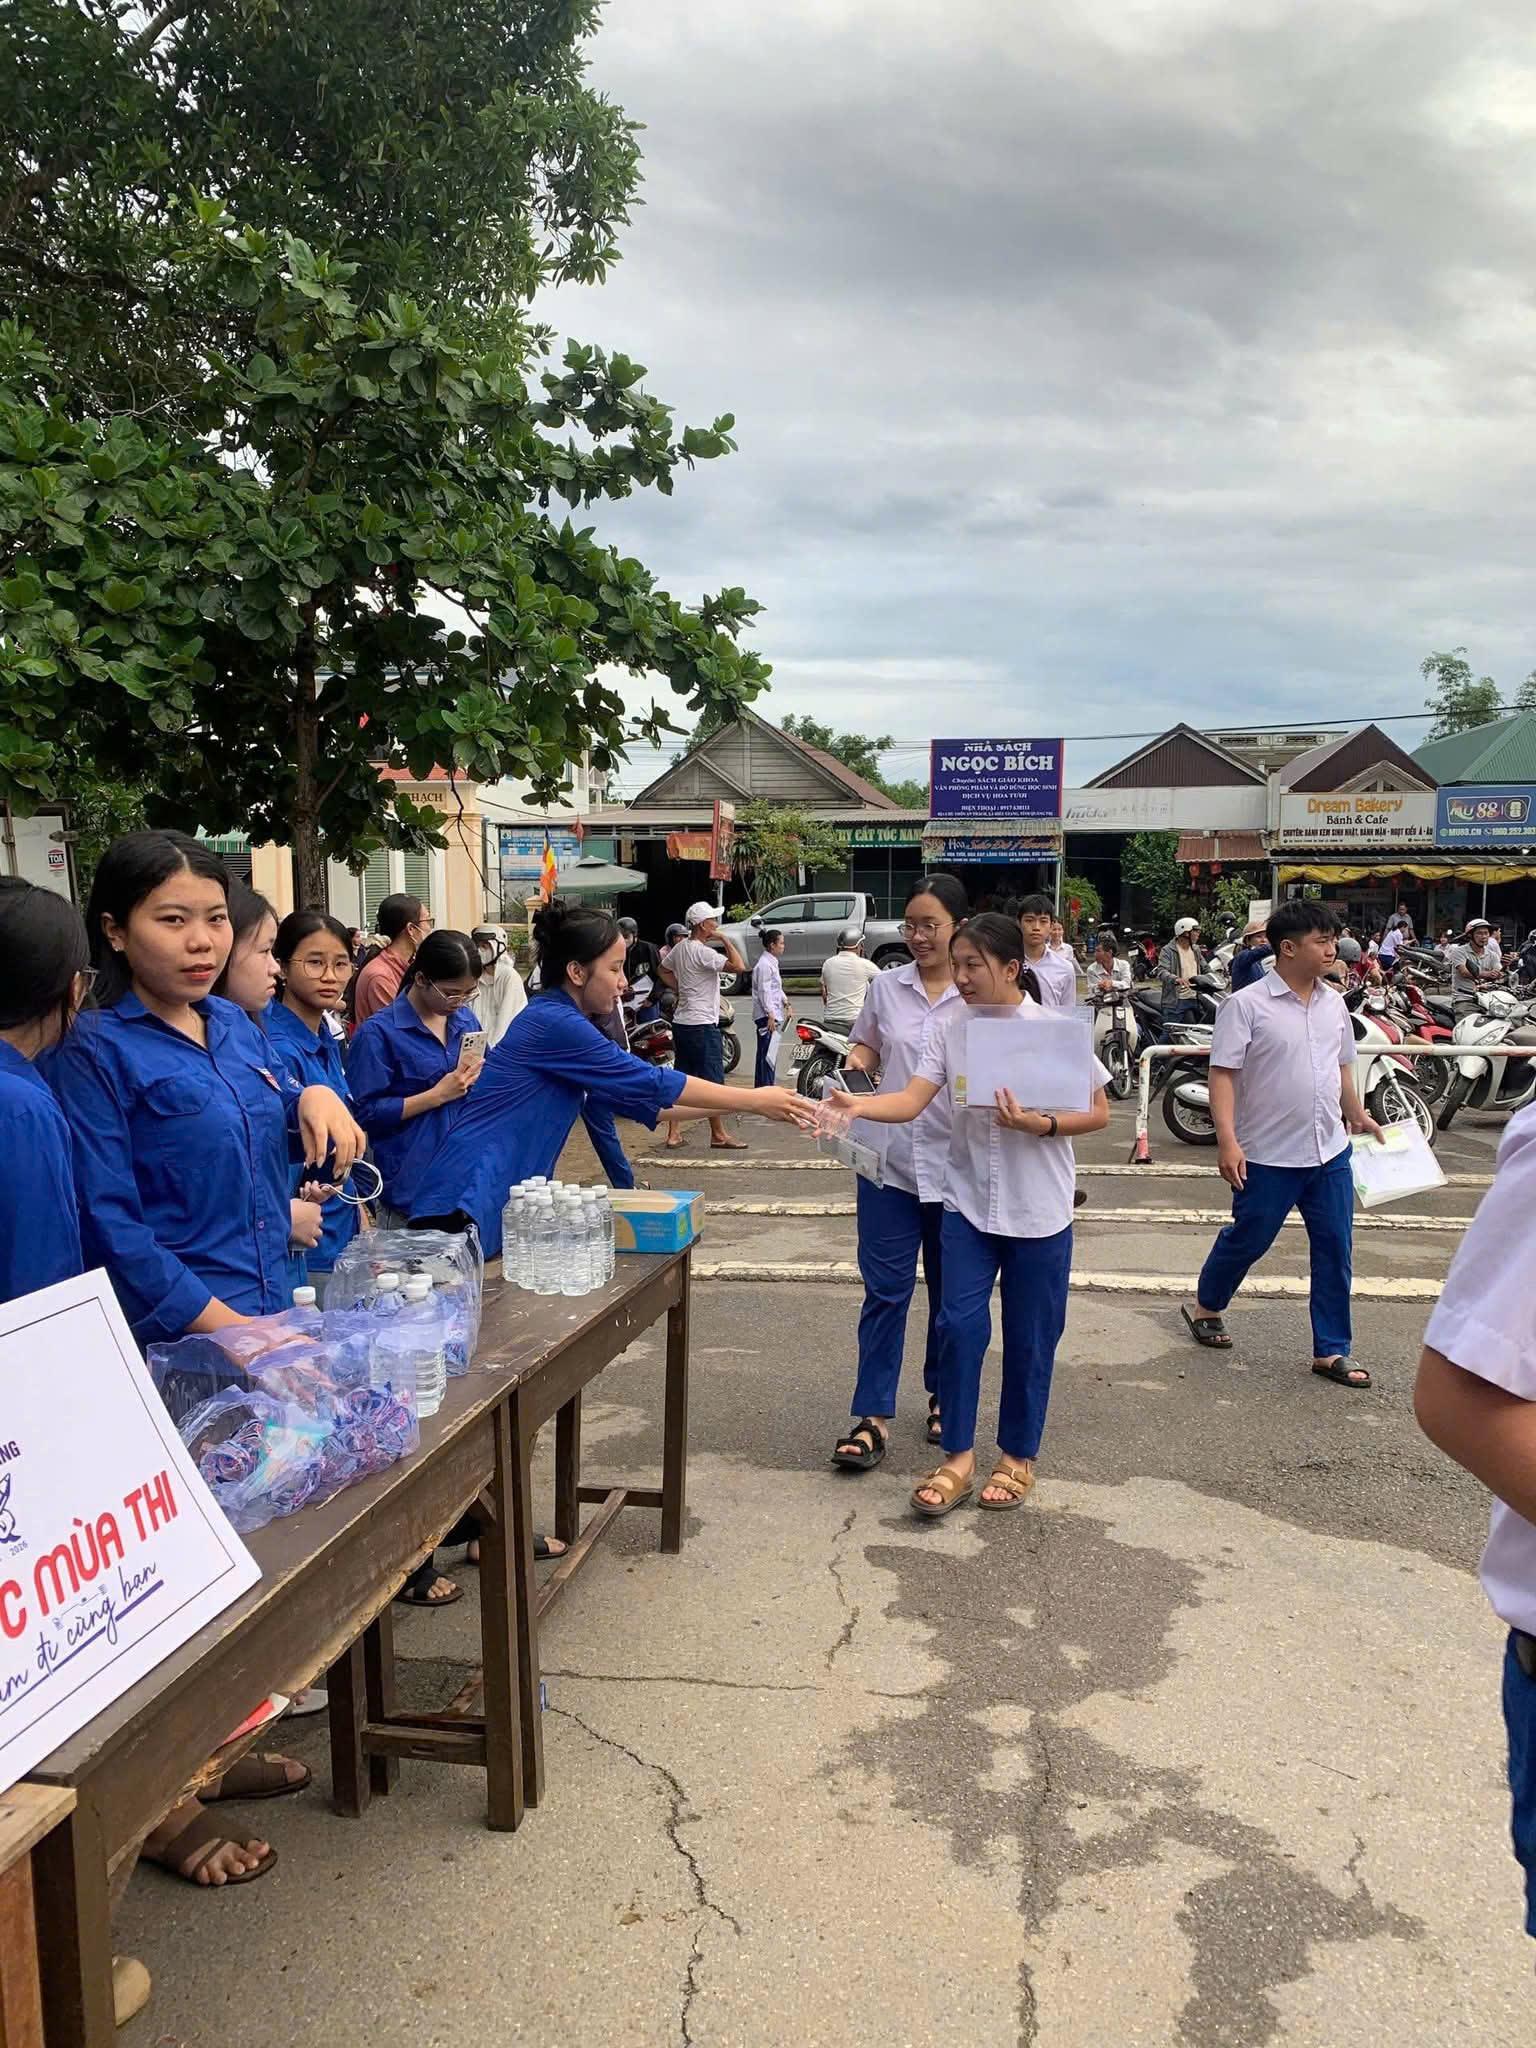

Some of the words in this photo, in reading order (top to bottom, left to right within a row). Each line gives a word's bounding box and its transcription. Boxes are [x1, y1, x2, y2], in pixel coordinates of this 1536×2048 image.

[996, 740, 1032, 752] SÁCH
[941, 756, 999, 775] NGỌC
[1004, 752, 1054, 771] BÍCH
[408, 793, 443, 803] HẠCH
[1308, 799, 1350, 812] Dream
[1355, 797, 1402, 812] Bakery
[1327, 815, 1353, 824] Bánh
[1355, 816, 1363, 824] &
[1365, 815, 1388, 824] Cafe
[855, 825, 876, 841] CẮT
[877, 825, 897, 841] TÓC
[48, 855, 64, 863] TOA
[0, 1440, 21, 1465] NG
[34, 1511, 125, 1617] MÙA
[123, 1470, 178, 1543] THI
[66, 1596, 118, 1646] cùng
[118, 1562, 156, 1602] bạn
